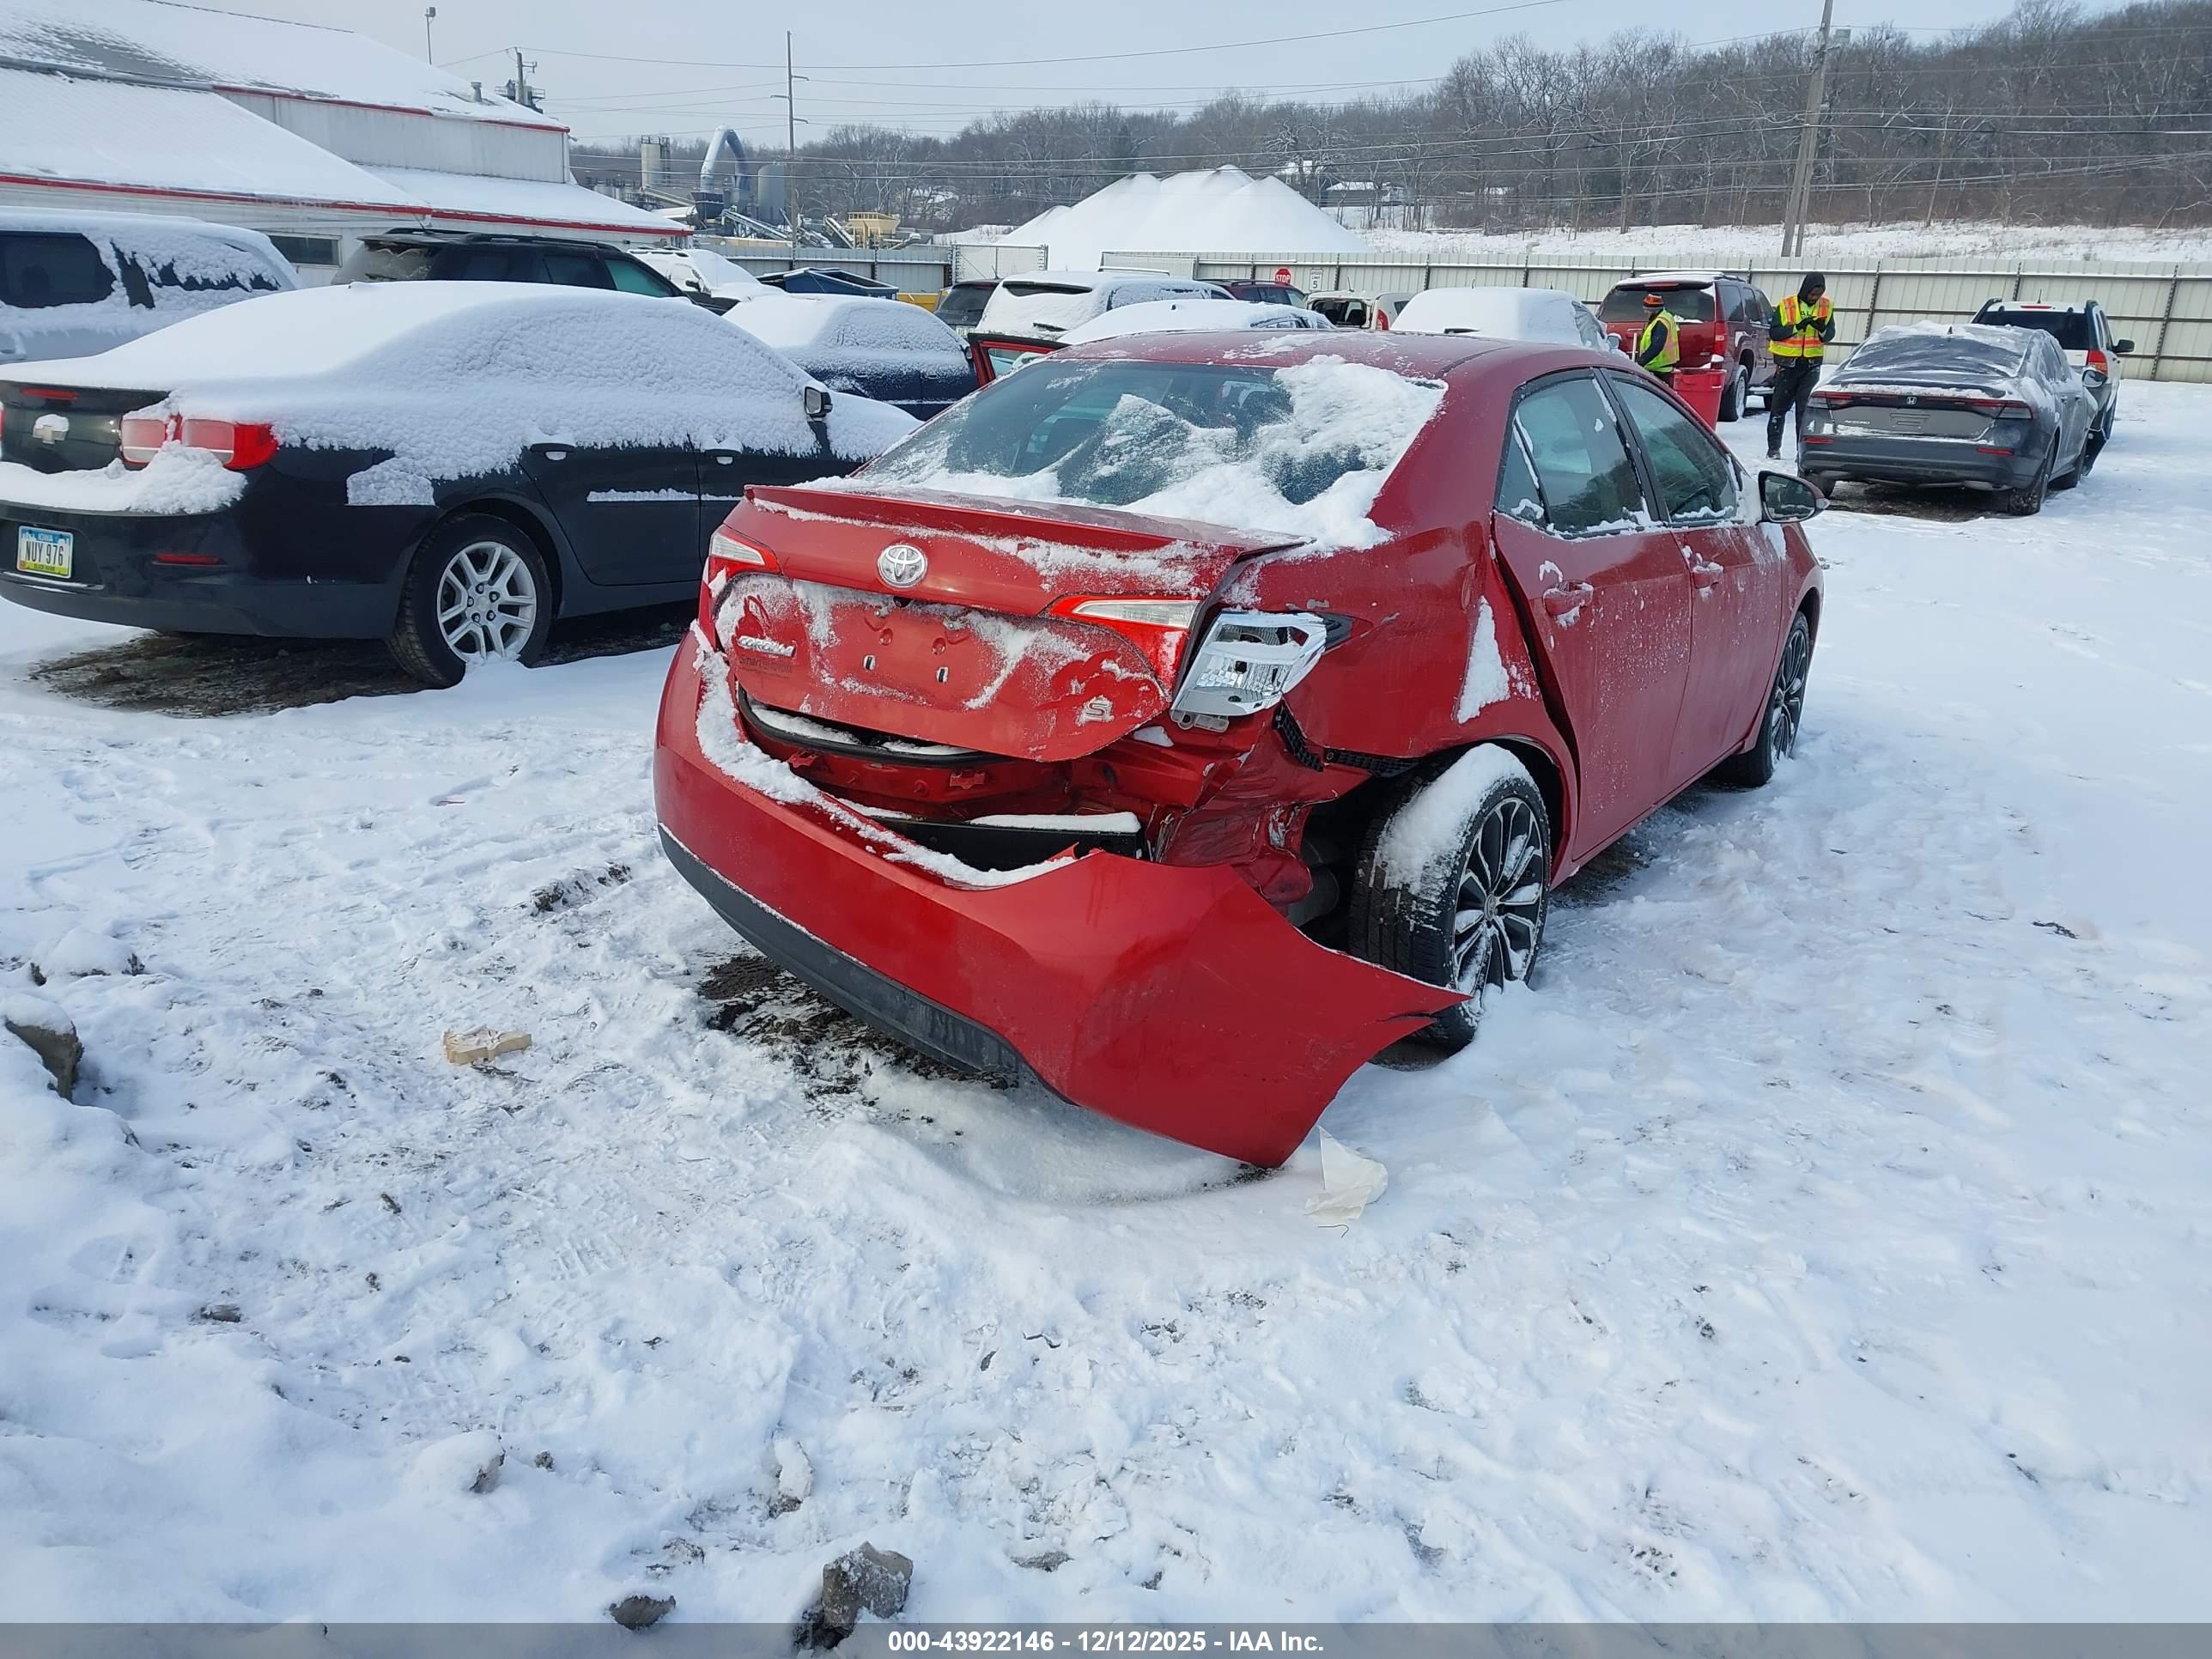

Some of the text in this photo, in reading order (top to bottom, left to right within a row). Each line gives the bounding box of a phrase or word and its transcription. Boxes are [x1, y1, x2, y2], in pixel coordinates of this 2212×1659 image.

[1275, 274, 1291, 283] STOP
[1312, 280, 1318, 289] 5
[25, 540, 64, 567] NUY 976
